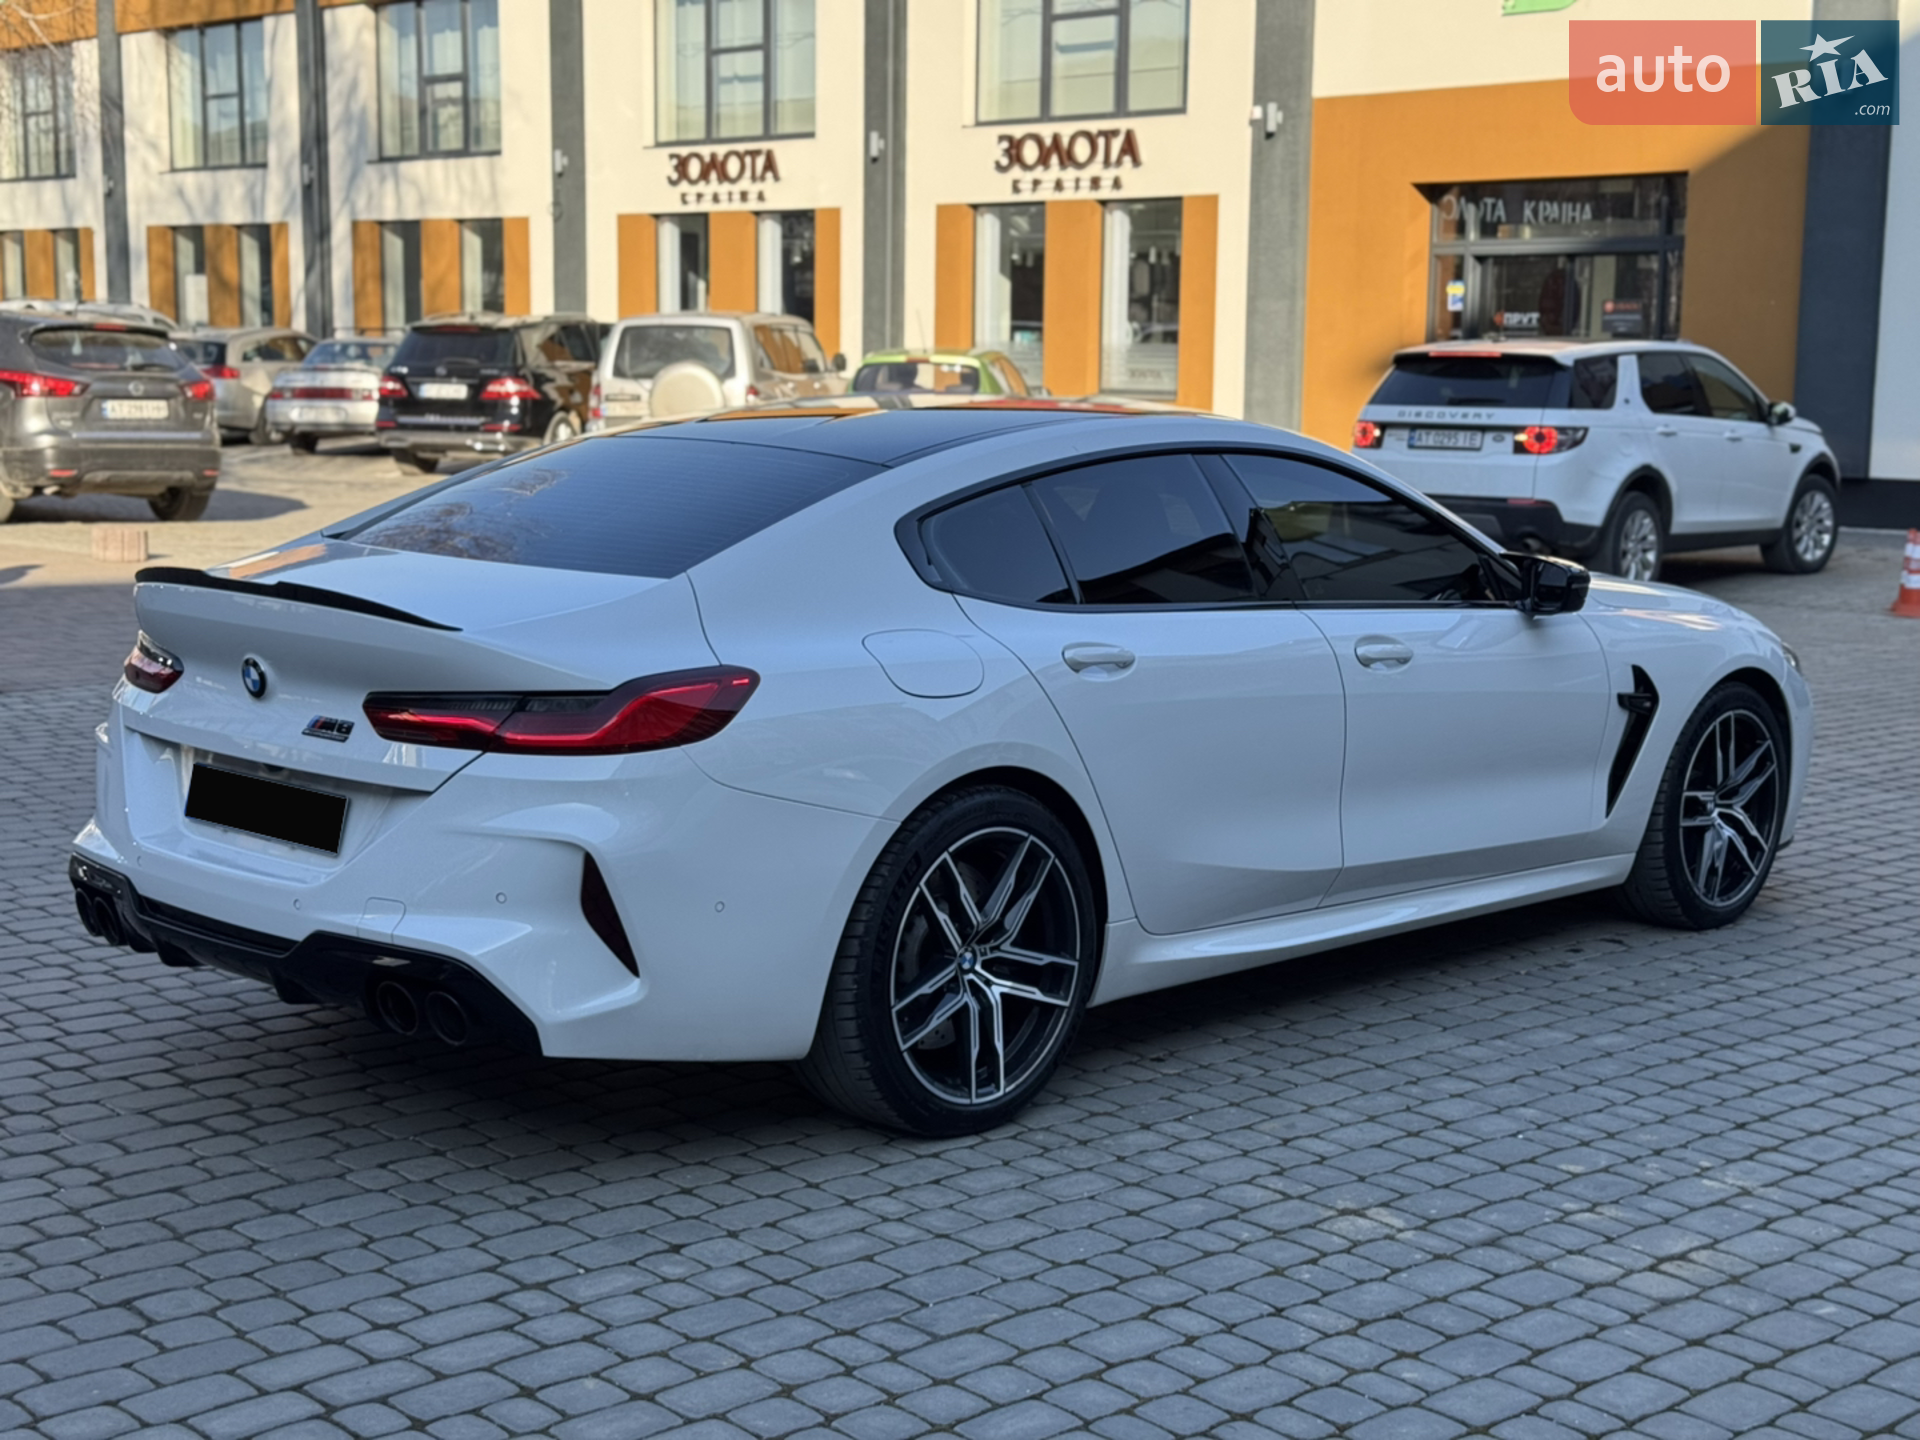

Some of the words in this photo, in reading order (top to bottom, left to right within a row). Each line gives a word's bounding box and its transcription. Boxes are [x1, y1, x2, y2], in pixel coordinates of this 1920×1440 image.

[995, 128, 1142, 174] ЗОЛОТА
[667, 149, 780, 187] ЗОЛОТА
[1397, 409, 1496, 420] DISCOVERY
[1417, 429, 1432, 440] AT
